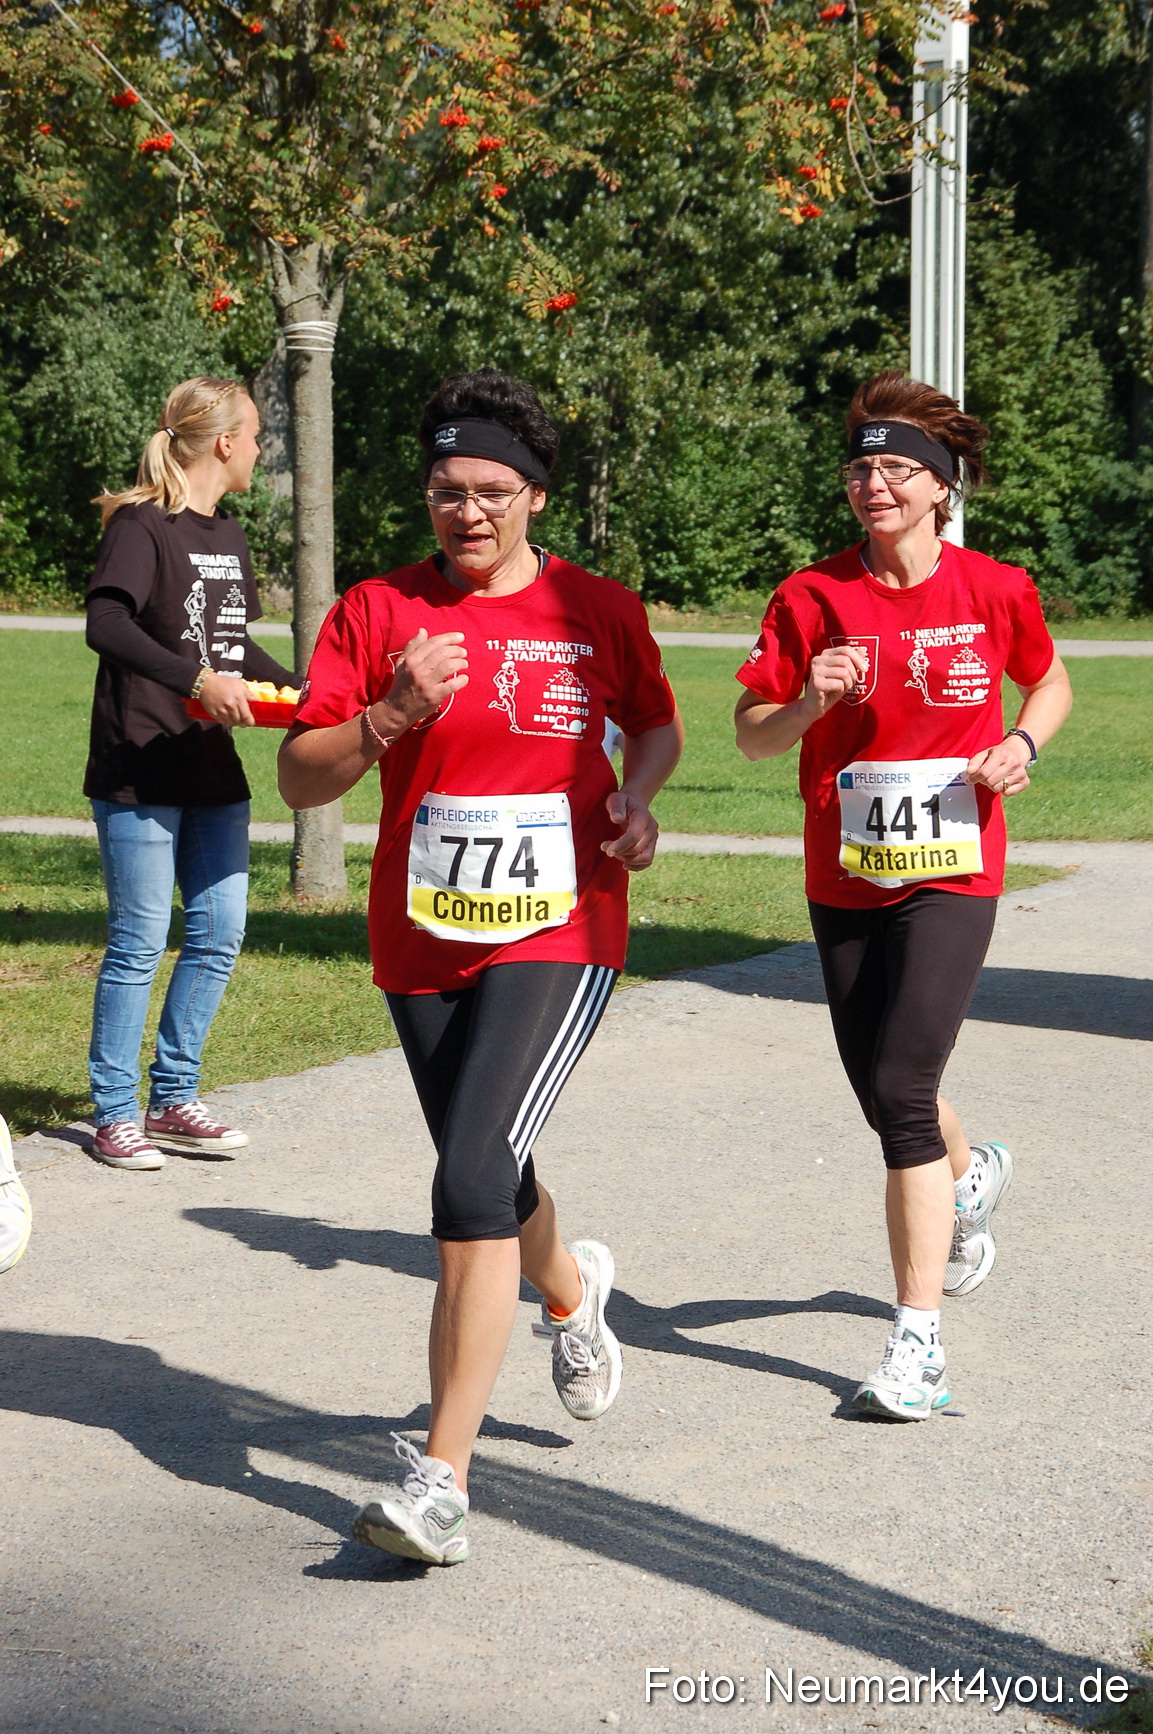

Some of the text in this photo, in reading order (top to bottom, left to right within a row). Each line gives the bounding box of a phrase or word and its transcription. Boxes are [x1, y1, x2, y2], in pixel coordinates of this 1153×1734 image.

[900, 624, 986, 640] 11. NEUMARKTER
[486, 639, 593, 656] 11. NEUMARKTER
[914, 634, 975, 648] STADTLAUF
[504, 651, 578, 664] STADTLAUF
[947, 677, 990, 687] 19.09.2010
[541, 703, 589, 716] 19.09.2010
[854, 772, 911, 783] PFLEIDERER
[430, 807, 499, 822] PFLEIDERER
[866, 794, 941, 841] 441
[440, 835, 539, 888] 774
[860, 845, 958, 871] Katarina
[433, 890, 549, 923] Cornelia
